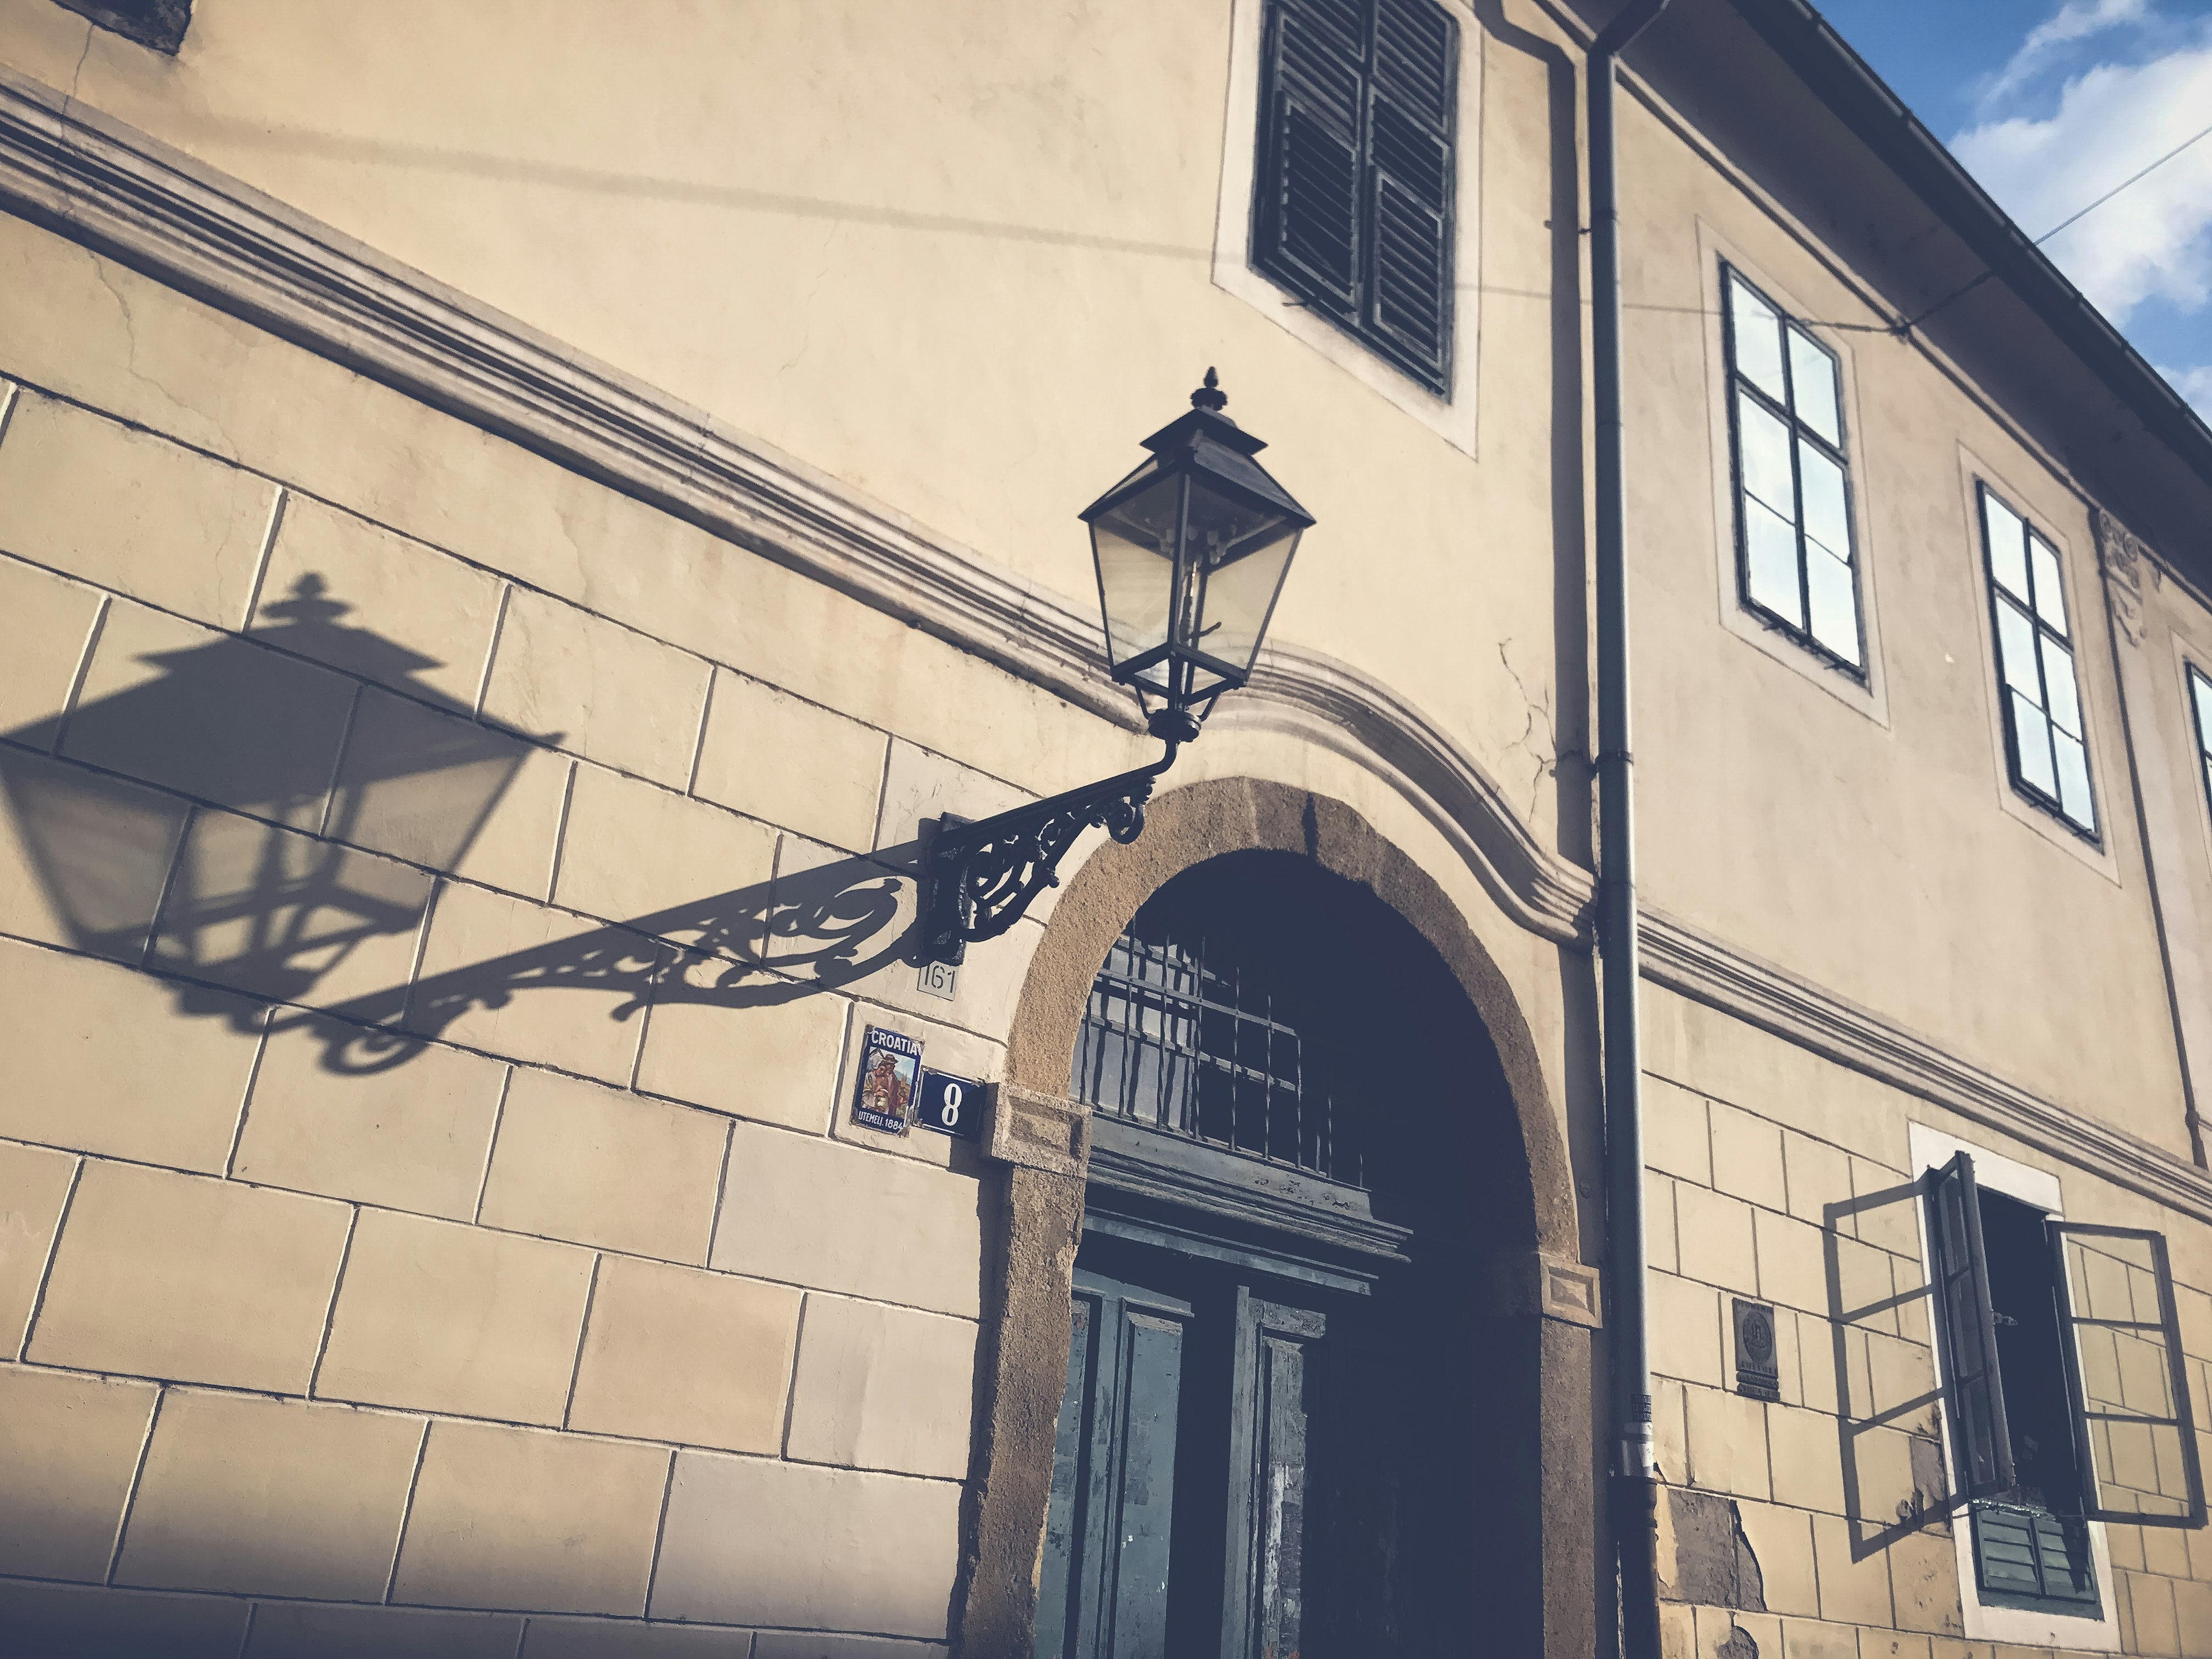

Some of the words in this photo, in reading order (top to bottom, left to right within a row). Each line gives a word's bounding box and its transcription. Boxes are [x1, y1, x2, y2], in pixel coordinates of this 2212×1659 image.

[925, 965, 956, 993] 161
[871, 1030, 918, 1056] CROATIA
[941, 1083, 963, 1126] 8
[885, 1118, 903, 1130] 1884
